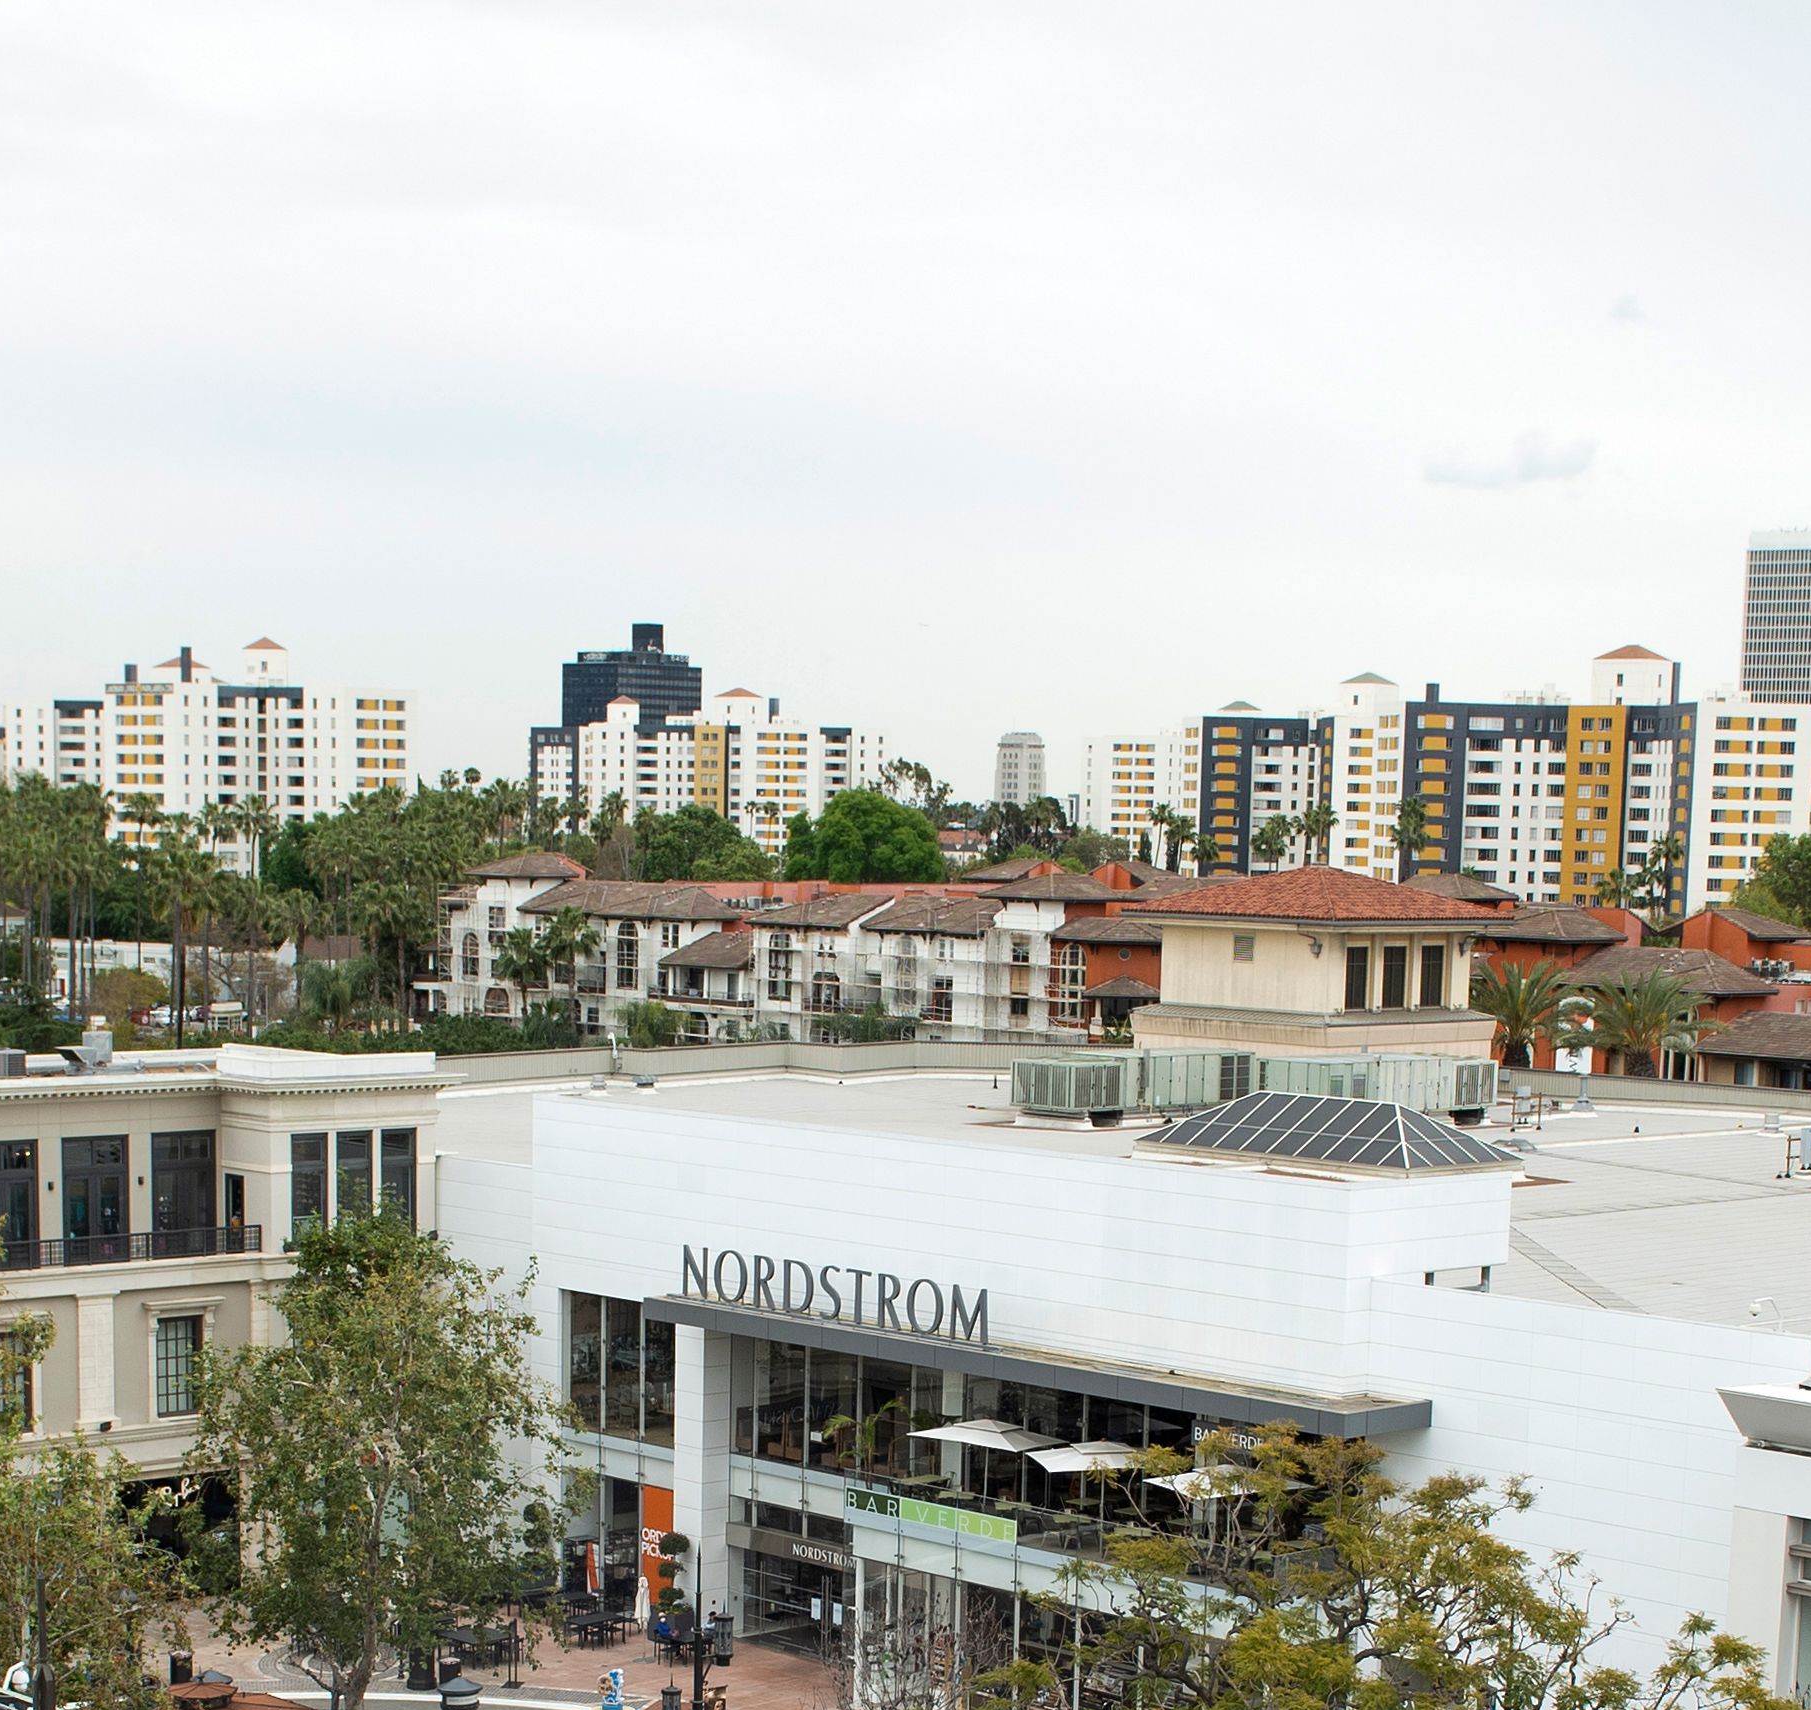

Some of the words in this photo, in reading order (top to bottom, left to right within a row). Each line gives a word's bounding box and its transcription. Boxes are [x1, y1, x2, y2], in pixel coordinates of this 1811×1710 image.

[683, 1244, 988, 1345] NORDSTROM
[847, 1490, 900, 1519] BAR
[915, 1506, 1016, 1542] VERDE
[792, 1543, 857, 1569] NORDSTROM
